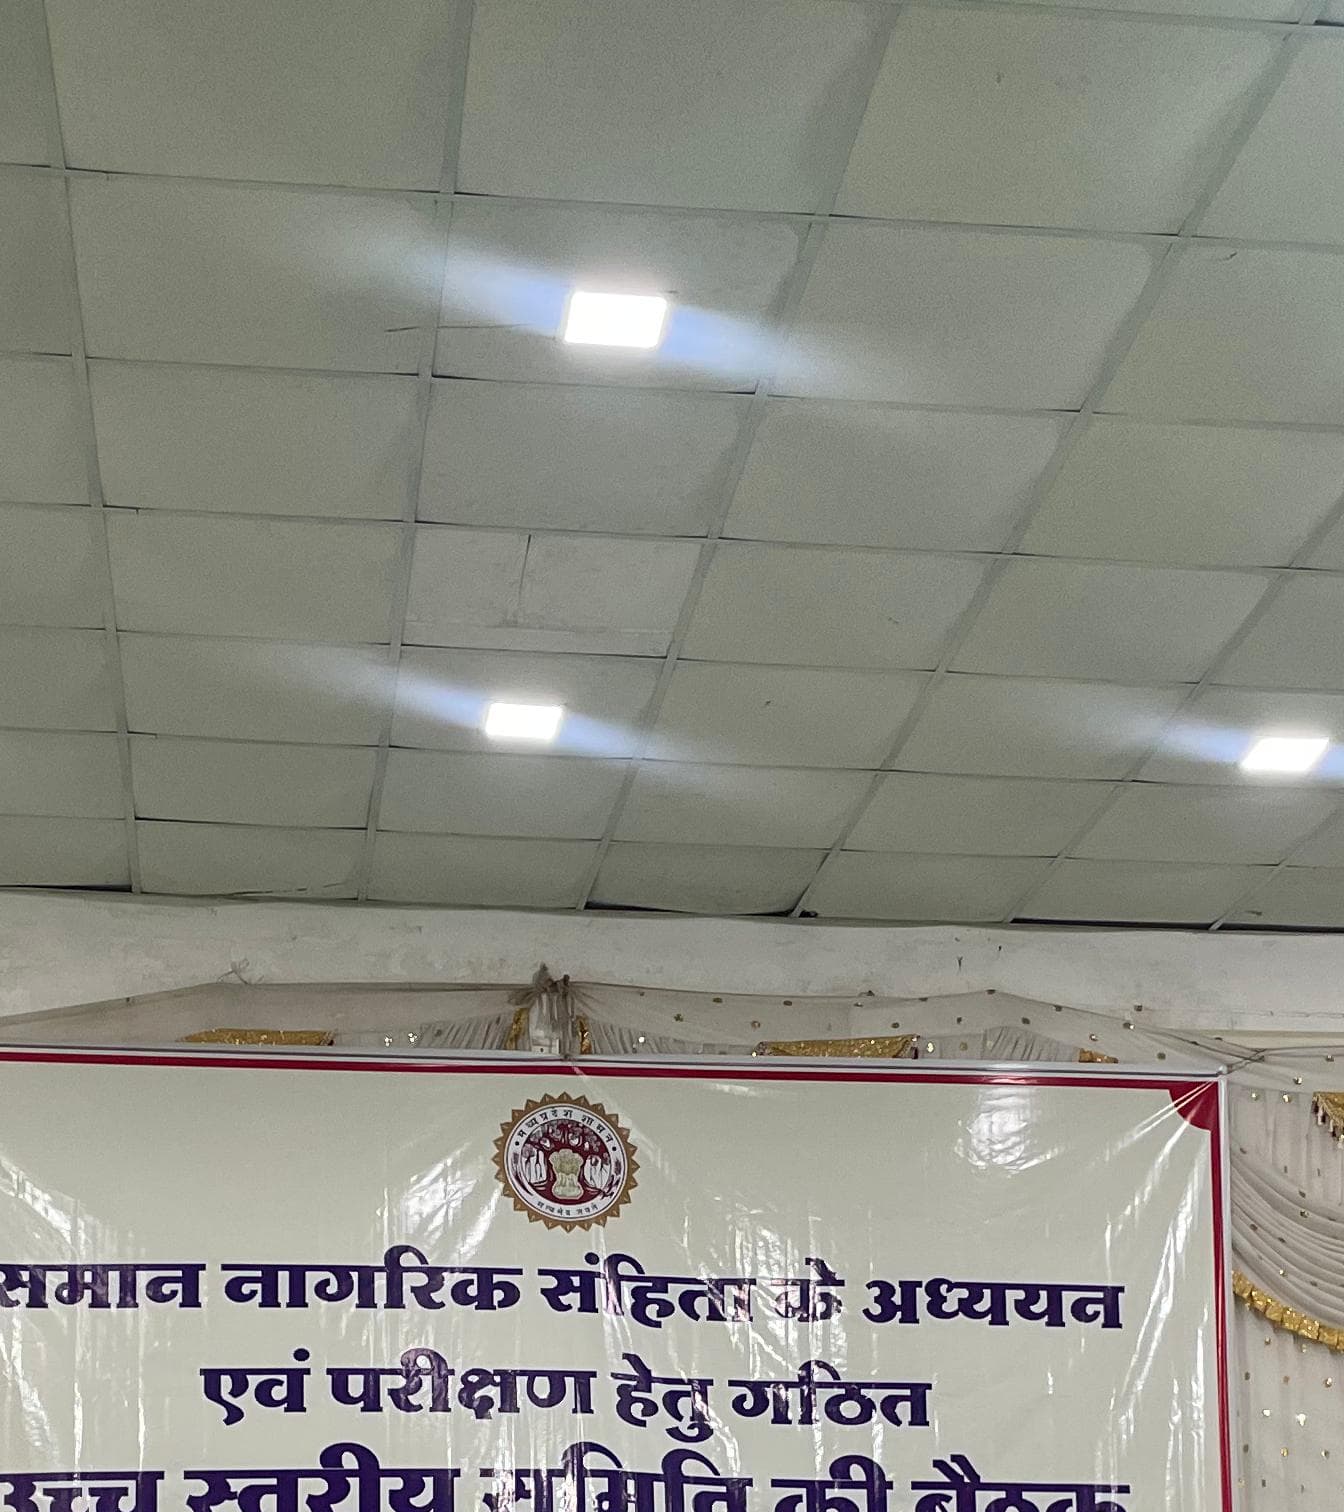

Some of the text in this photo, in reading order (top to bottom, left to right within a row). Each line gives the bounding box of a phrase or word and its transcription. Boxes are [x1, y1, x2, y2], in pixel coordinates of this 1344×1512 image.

[221, 1245, 524, 1311] नागरिक
[538, 1251, 756, 1328] संहिता
[771, 1258, 845, 1322] के
[862, 1277, 1125, 1329] अध्ययन
[200, 1348, 932, 1443] एवं परीक्षण हेतु गठित
